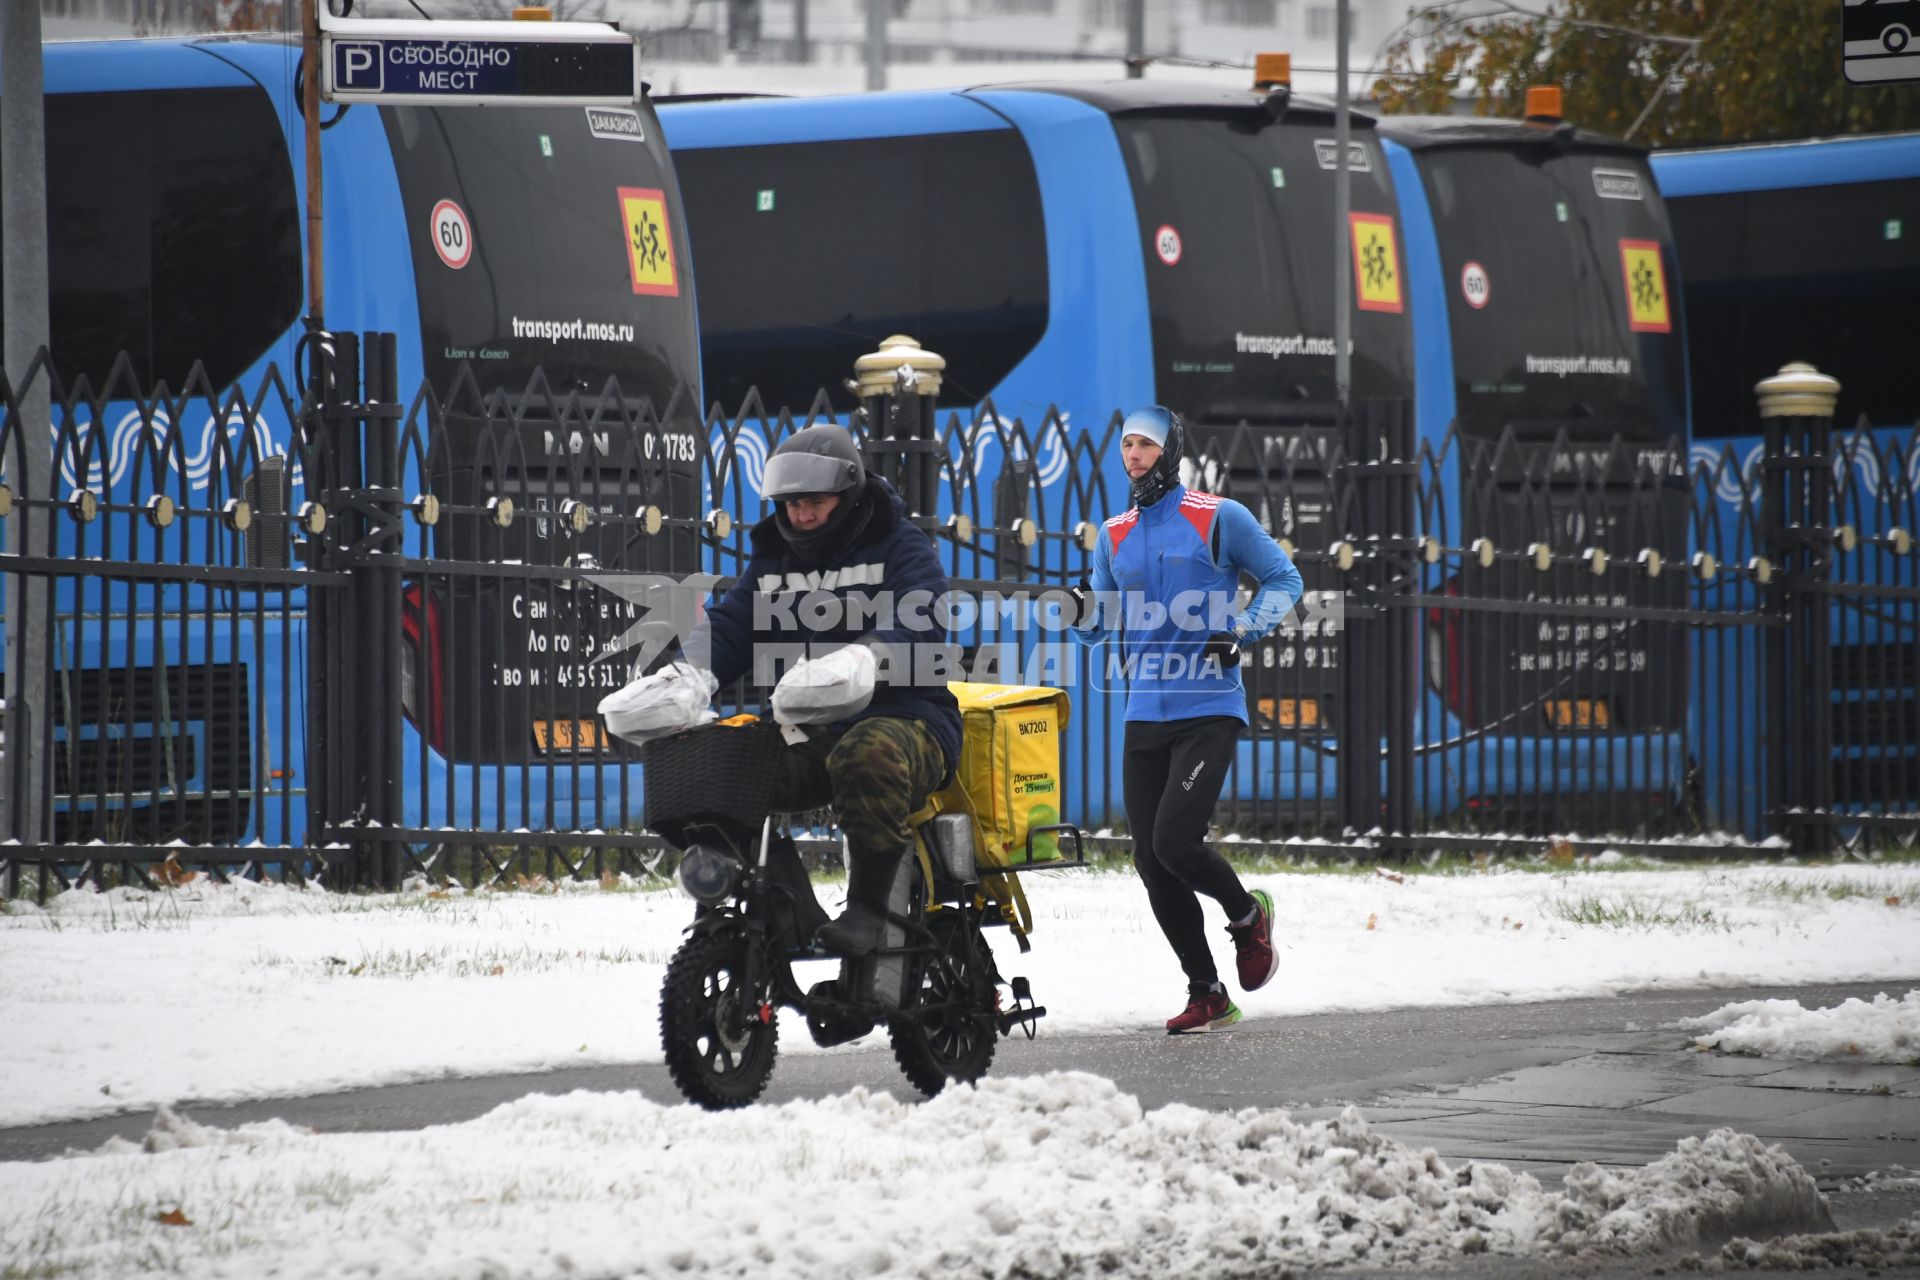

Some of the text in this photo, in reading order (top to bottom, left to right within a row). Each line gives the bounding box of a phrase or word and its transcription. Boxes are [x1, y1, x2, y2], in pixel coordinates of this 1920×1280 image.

[388, 46, 511, 68] СВОБОДНО
[418, 71, 479, 90] МЕСТ
[591, 114, 639, 134] ЗАКАЗНОЙ
[440, 221, 463, 248] 60
[1161, 235, 1176, 255] 60
[1466, 276, 1483, 295] 60
[512, 316, 634, 344] transport.mos.ru
[1525, 354, 1631, 378] transport.mos.ru
[1014, 773, 1048, 783] Доставка
[1015, 786, 1023, 794] от
